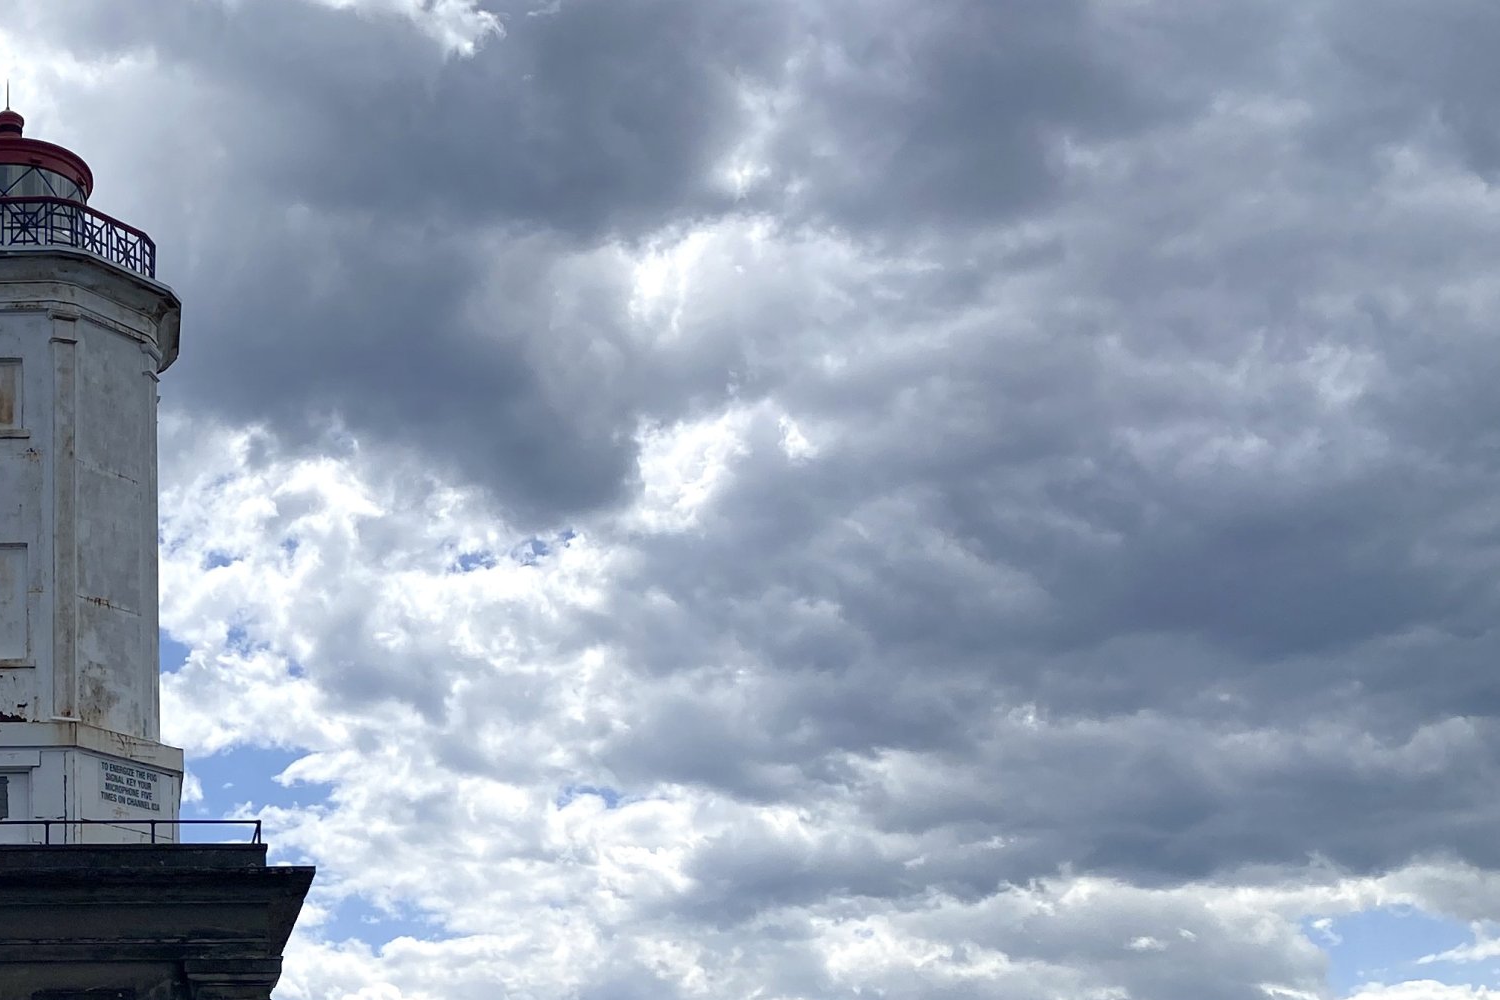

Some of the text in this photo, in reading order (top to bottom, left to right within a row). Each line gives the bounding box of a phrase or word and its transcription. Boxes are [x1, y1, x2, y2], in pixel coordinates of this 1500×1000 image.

[101, 762, 157, 782] TO ENERGIZE THE FOG
[106, 773, 151, 790] SIGNAL KEY YOUR
[105, 782, 152, 800] MICROPHONE FIVE
[101, 791, 117, 802] TIMES
[118, 795, 125, 804] ON
[127, 798, 150, 810] CHANNEL
